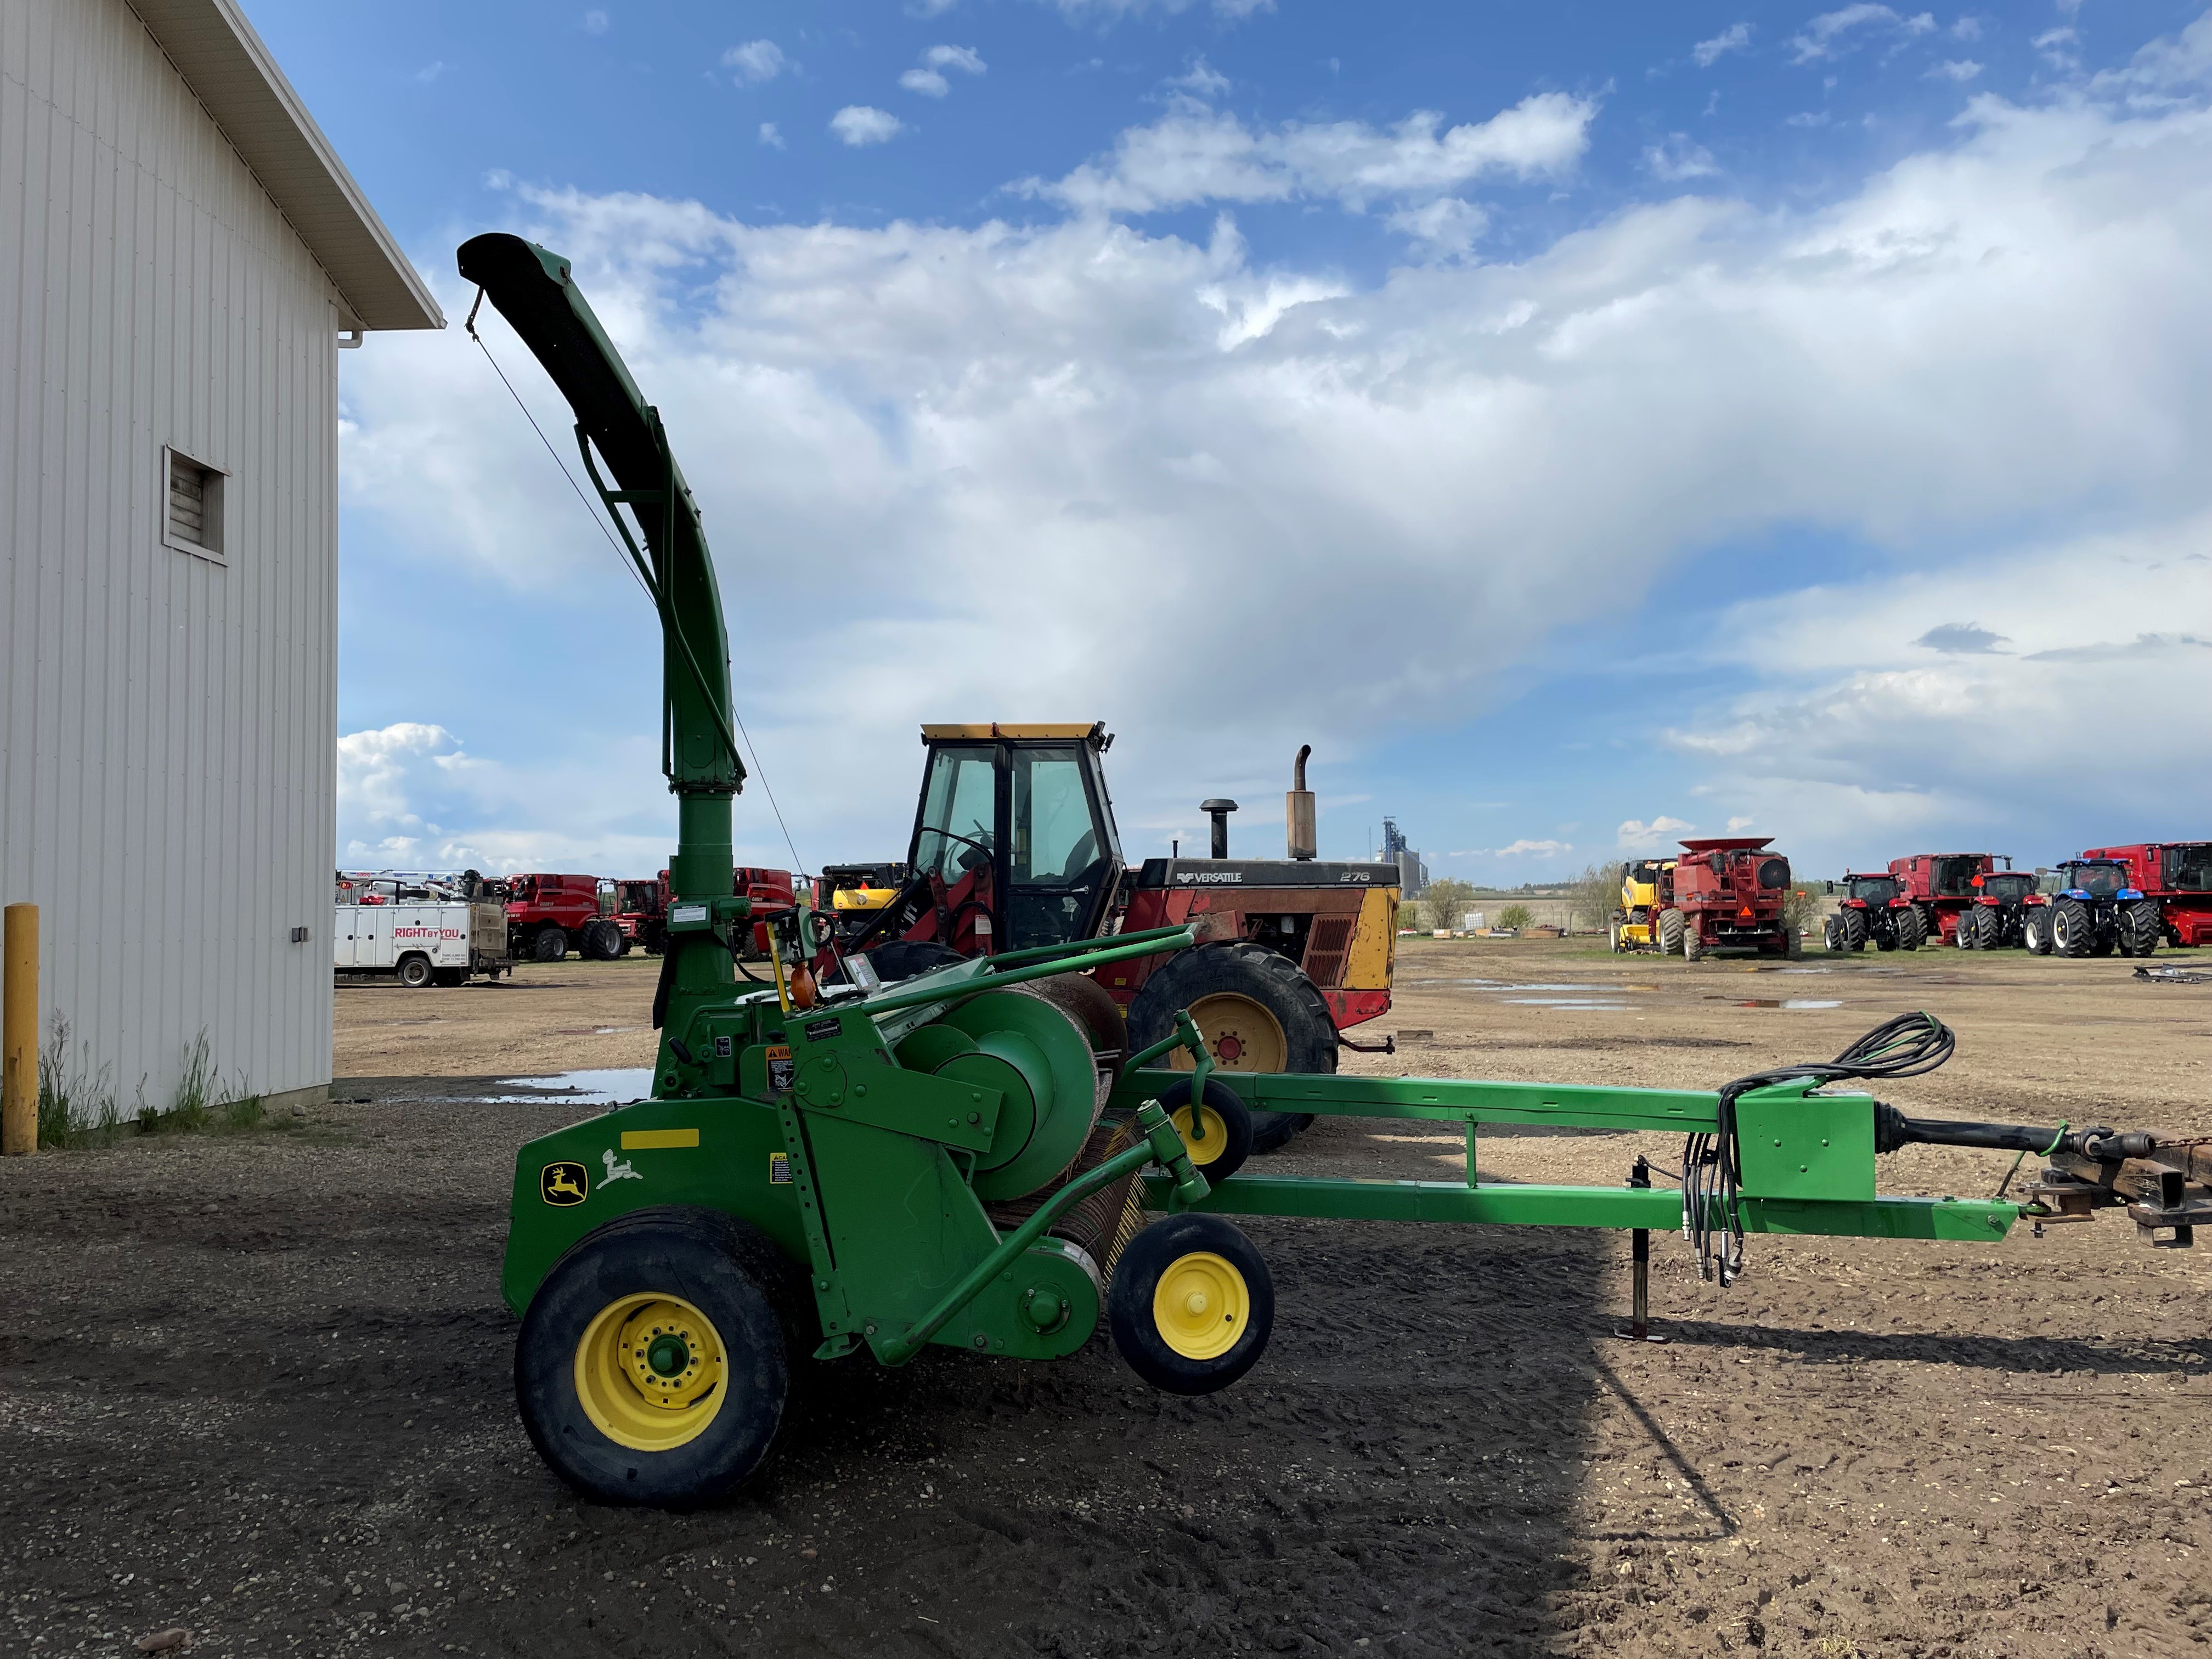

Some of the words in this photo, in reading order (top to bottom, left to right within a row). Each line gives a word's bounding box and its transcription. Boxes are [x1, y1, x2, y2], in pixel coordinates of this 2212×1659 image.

[1194, 872, 1243, 883] VERSATILE
[1340, 872, 1371, 882] 276
[395, 928, 428, 938] RIGHT
[439, 929, 459, 938] YOU
